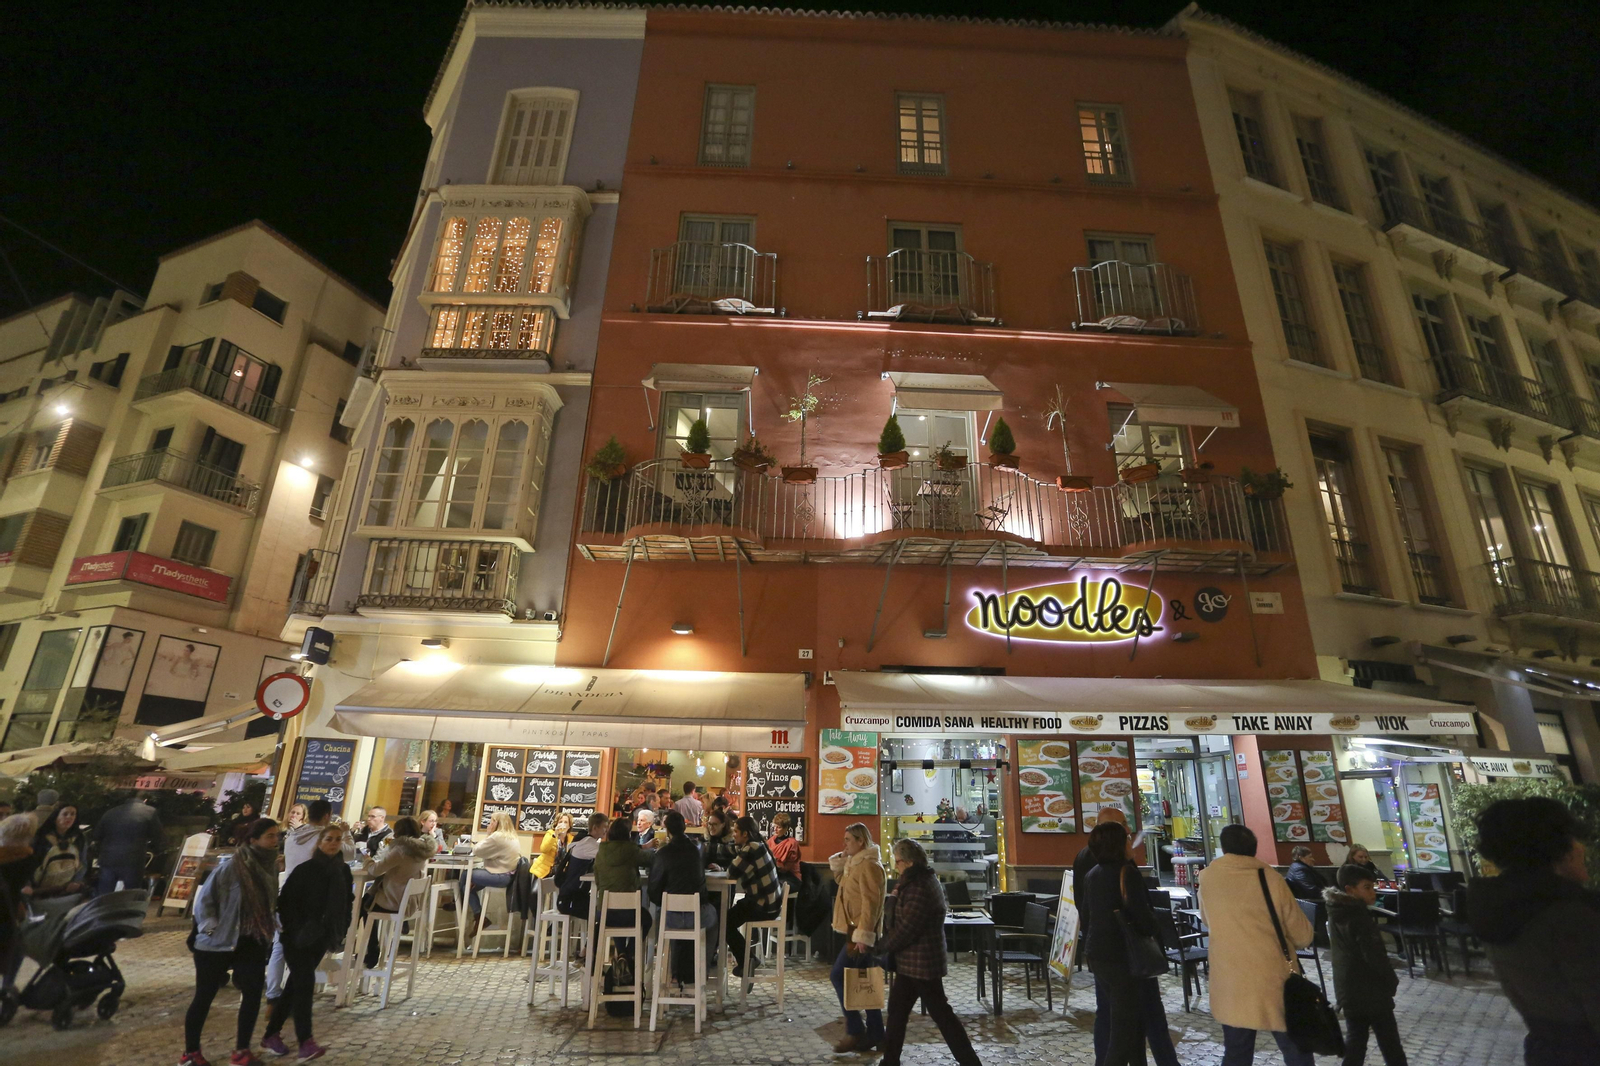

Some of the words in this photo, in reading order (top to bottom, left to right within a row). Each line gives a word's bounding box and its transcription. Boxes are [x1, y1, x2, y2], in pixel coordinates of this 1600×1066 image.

[973, 576, 1164, 637] noodles
[1170, 600, 1192, 621] &
[801, 650, 810, 658] 27
[845, 715, 890, 726] Cruzcampo
[896, 716, 941, 728] COMIDA
[945, 716, 974, 728] SANA
[981, 717, 1029, 729] HEALTHY
[1033, 717, 1062, 729] FOOD
[1119, 715, 1168, 731] PIZZAS
[1232, 715, 1270, 731] TAKE
[1274, 715, 1312, 731] AWAY
[1375, 715, 1409, 731] WOK
[1430, 718, 1470, 729] Cruzcampo
[522, 729, 563, 737] PINTXOS
[582, 730, 609, 738] TAPAS
[323, 743, 351, 753] Chacina
[496, 749, 519, 760] Tapas
[765, 759, 799, 770] Cervezas
[170, 777, 198, 788] Olivo
[765, 772, 789, 782] Vinos
[747, 799, 773, 811] Drinks
